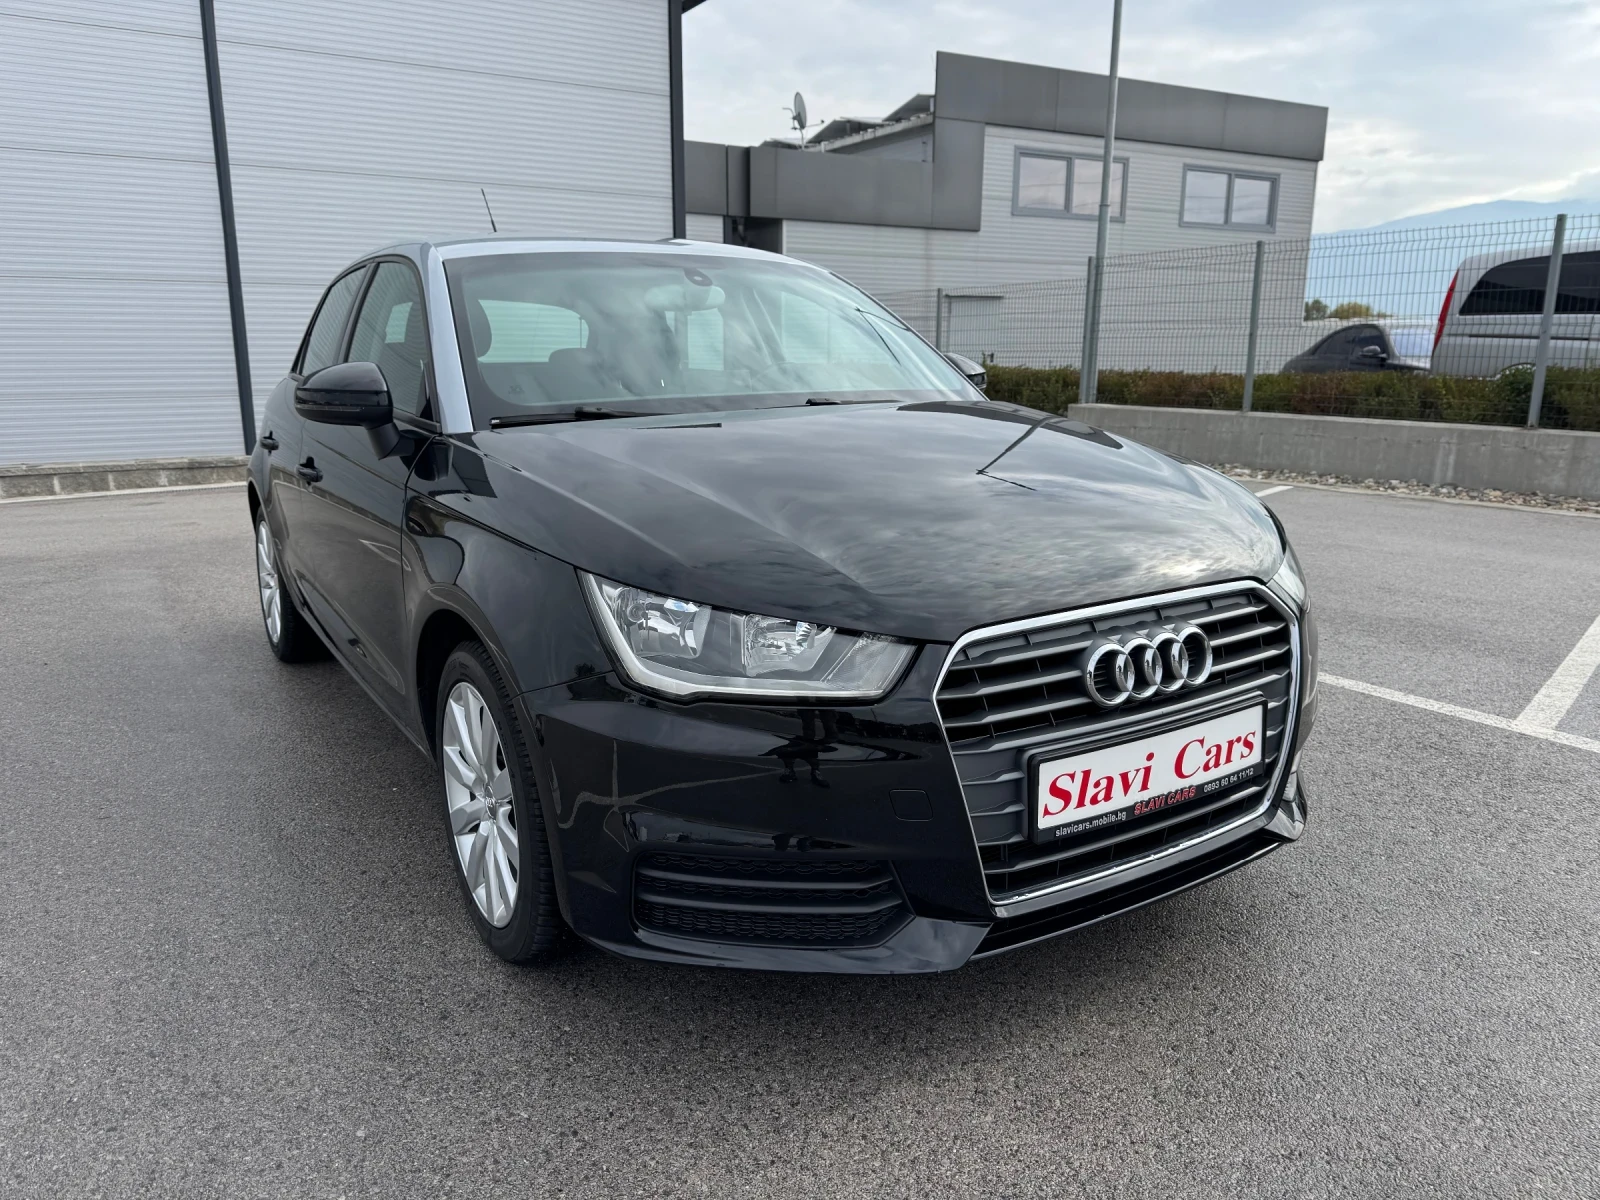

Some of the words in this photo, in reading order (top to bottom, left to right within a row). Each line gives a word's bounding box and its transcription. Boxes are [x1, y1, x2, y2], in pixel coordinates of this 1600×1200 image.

[1042, 752, 1155, 818] Slavi
[1174, 730, 1256, 779] Cars
[1133, 795, 1166, 816] SLAVI
[1167, 785, 1197, 805] CARS
[1055, 811, 1127, 837] slavicars.mobile.bg
